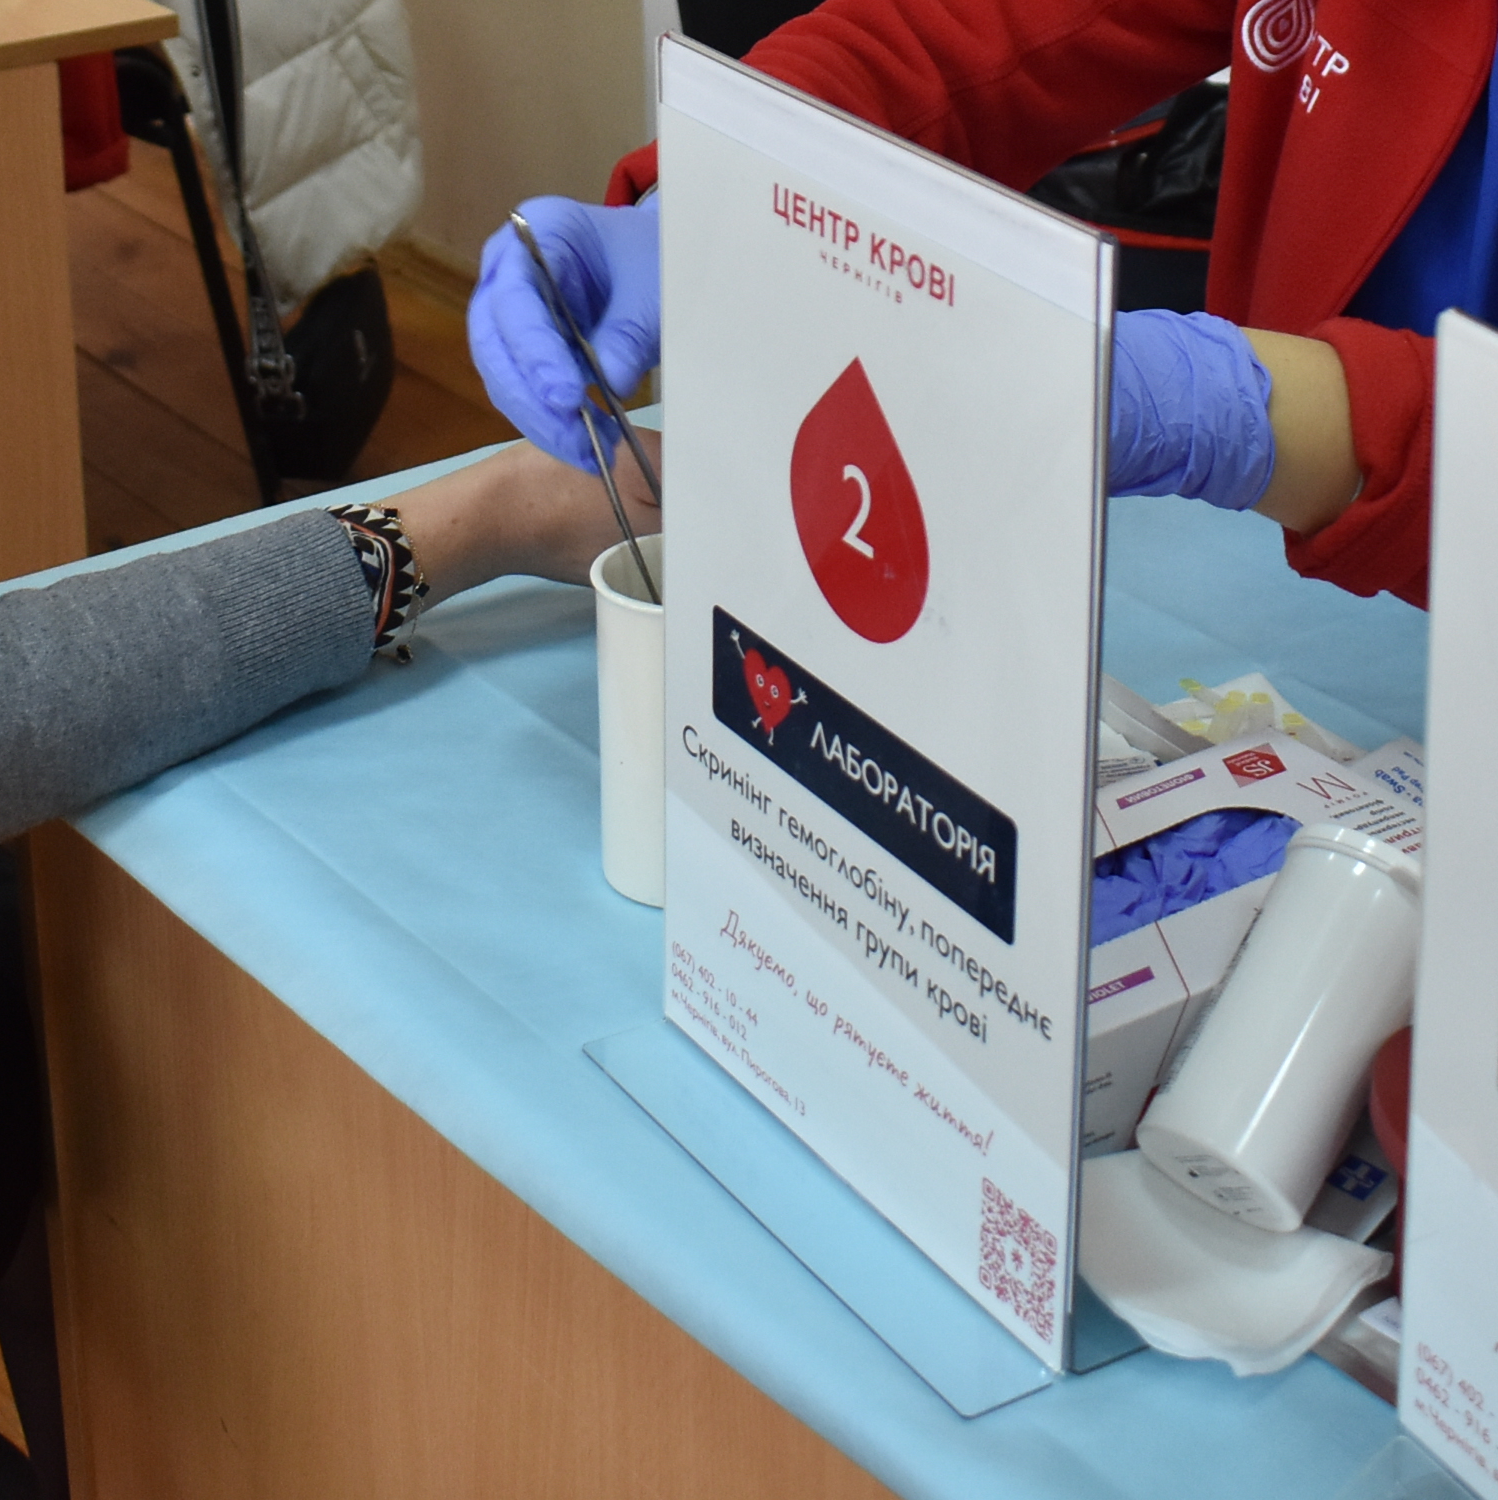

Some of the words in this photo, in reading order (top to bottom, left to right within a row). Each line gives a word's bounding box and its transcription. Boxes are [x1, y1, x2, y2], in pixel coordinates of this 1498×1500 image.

[773, 182, 861, 251] ЦЕНТР
[870, 232, 956, 308] КРОВІ
[819, 250, 904, 304] ЧЕРНІГІВ
[842, 463, 875, 560] 2
[809, 721, 997, 884] ЛАБОРАТОРІЯ
[682, 725, 773, 815] Скринінг
[778, 806, 916, 936] гемоглобіну,
[920, 919, 1054, 1042] попереднє
[731, 818, 850, 931] визначення
[856, 920, 919, 988] групи
[927, 977, 988, 1045] крові
[805, 990, 829, 1016] що
